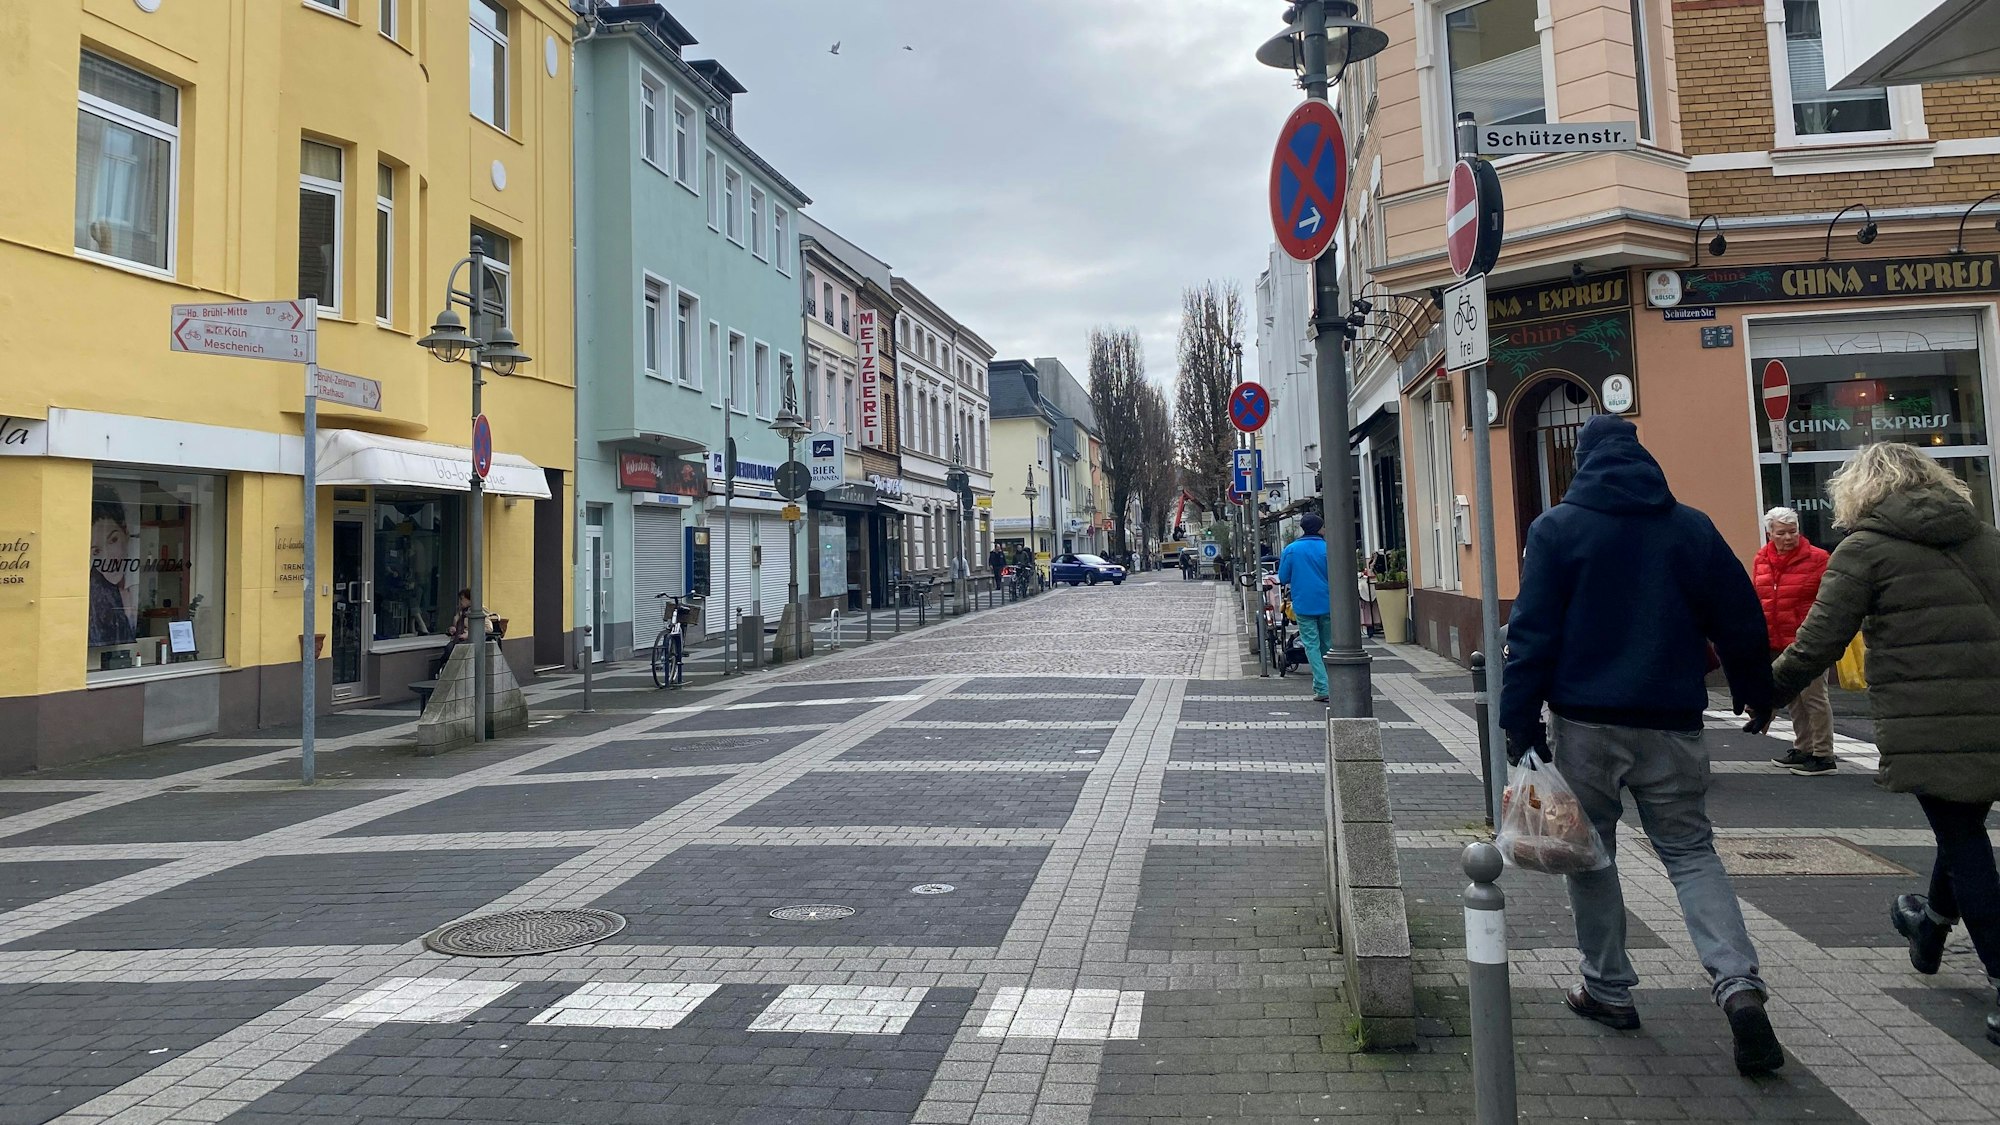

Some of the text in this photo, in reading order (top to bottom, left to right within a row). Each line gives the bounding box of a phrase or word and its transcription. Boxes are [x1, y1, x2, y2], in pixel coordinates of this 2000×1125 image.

[1486, 128, 1627, 147] Schützenstr.
[1706, 270, 1746, 282] chin's
[1782, 266, 1864, 296] CHINA
[1885, 260, 1994, 291] EXPRESS
[1487, 296, 1522, 319] INA
[1538, 278, 1625, 312] EXPRESS
[202, 307, 247, 318] Brühl-Mitte
[224, 326, 299, 344] Köln 13
[1510, 320, 1577, 345] chin's
[204, 339, 264, 354] Meschenich
[1460, 337, 1474, 358] frei
[860, 312, 877, 443] METZGEREI
[1788, 418, 1851, 433] CHINA
[1871, 413, 1950, 430] EXPRESS
[432, 459, 507, 490] bb-boque
[812, 465, 836, 475] BIER
[1791, 498, 1832, 511] HIN
[0, 537, 30, 552] nto
[0, 552, 30, 570] oda
[91, 558, 184, 573] PUNTO MODA
